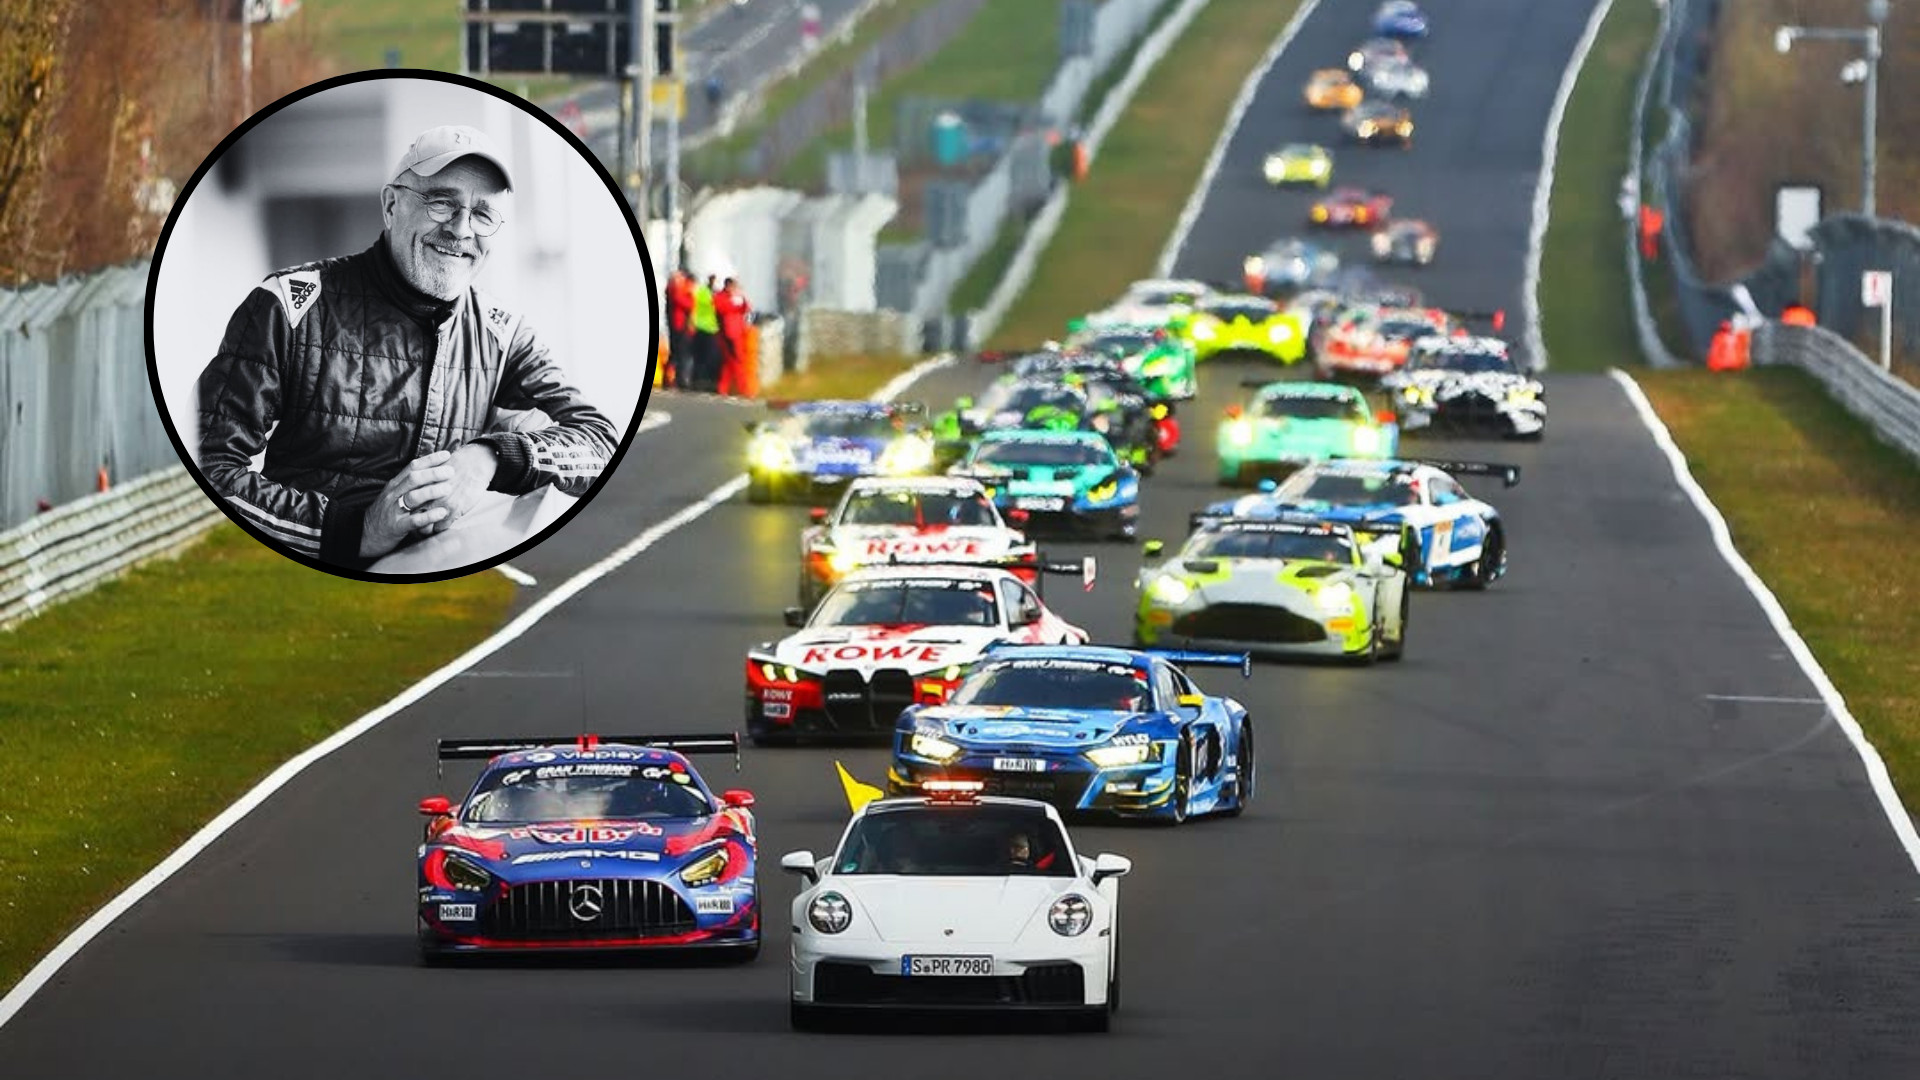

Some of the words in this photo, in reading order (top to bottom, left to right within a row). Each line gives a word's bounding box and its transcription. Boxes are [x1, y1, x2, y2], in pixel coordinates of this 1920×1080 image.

[294, 282, 317, 309] adidas
[866, 540, 983, 556] ROWE
[802, 645, 947, 663] ROWE
[562, 750, 645, 761] viaplay
[560, 849, 661, 862] AMG
[913, 959, 922, 973] S
[932, 959, 950, 974] PR
[954, 959, 991, 974] 7980
